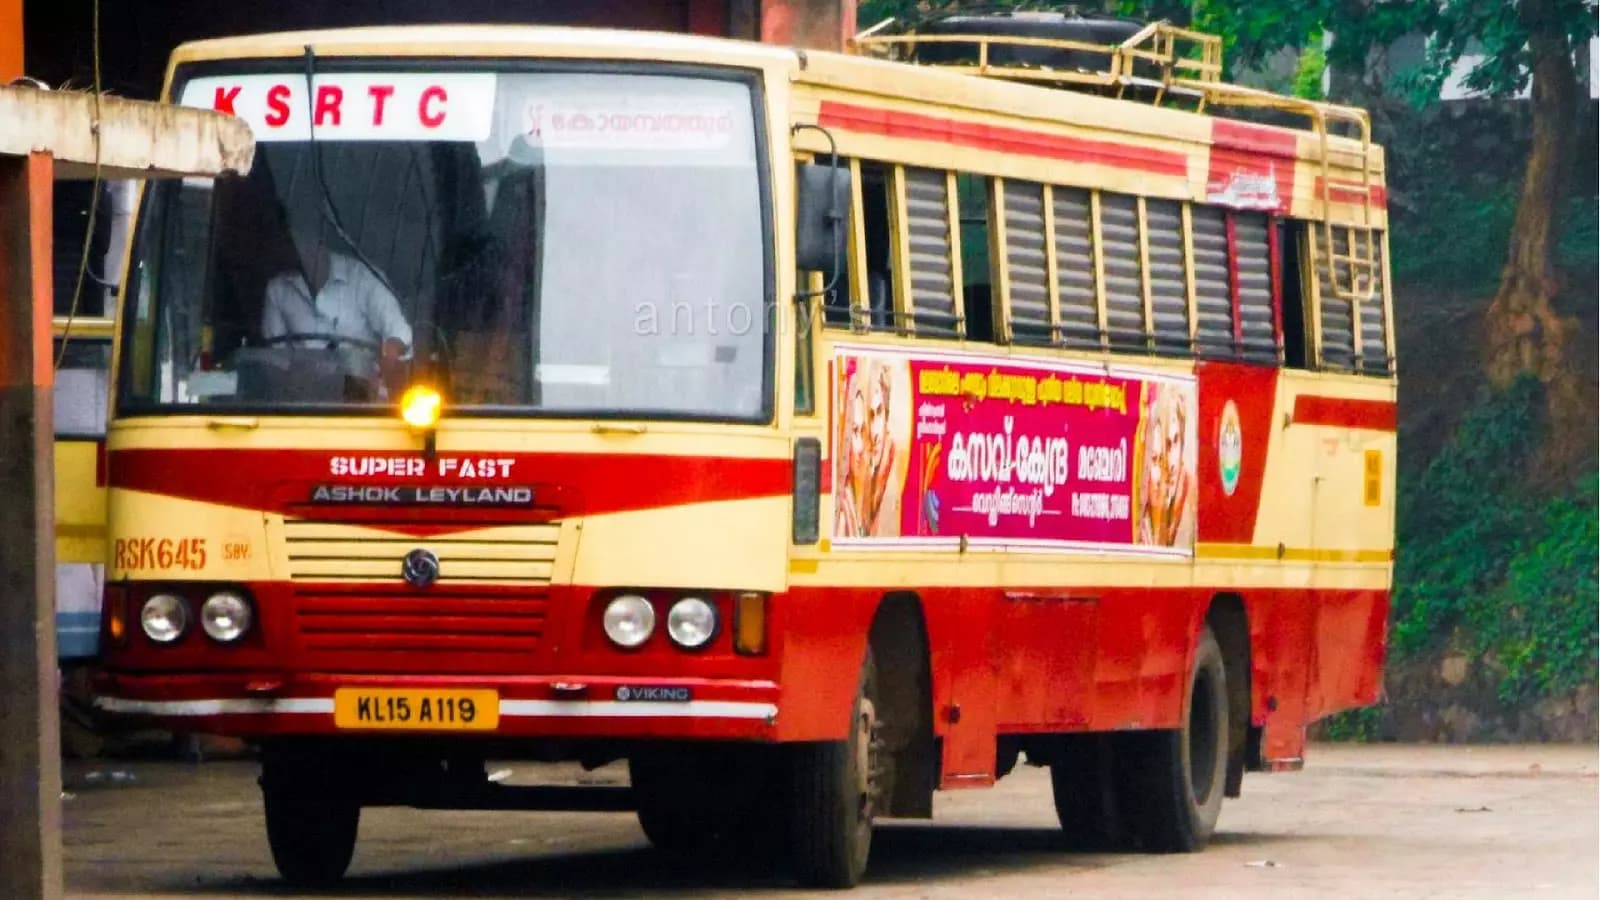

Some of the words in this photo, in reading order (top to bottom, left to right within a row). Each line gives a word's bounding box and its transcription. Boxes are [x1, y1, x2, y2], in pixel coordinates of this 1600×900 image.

[329, 456, 425, 476] SUPER
[438, 458, 516, 478] FAST
[313, 486, 401, 502] ASHOK
[415, 486, 532, 502] LEYLAND
[114, 536, 208, 570] RSK645
[632, 687, 689, 700] VIKING
[357, 696, 412, 722] KL15
[419, 696, 476, 723] A119
